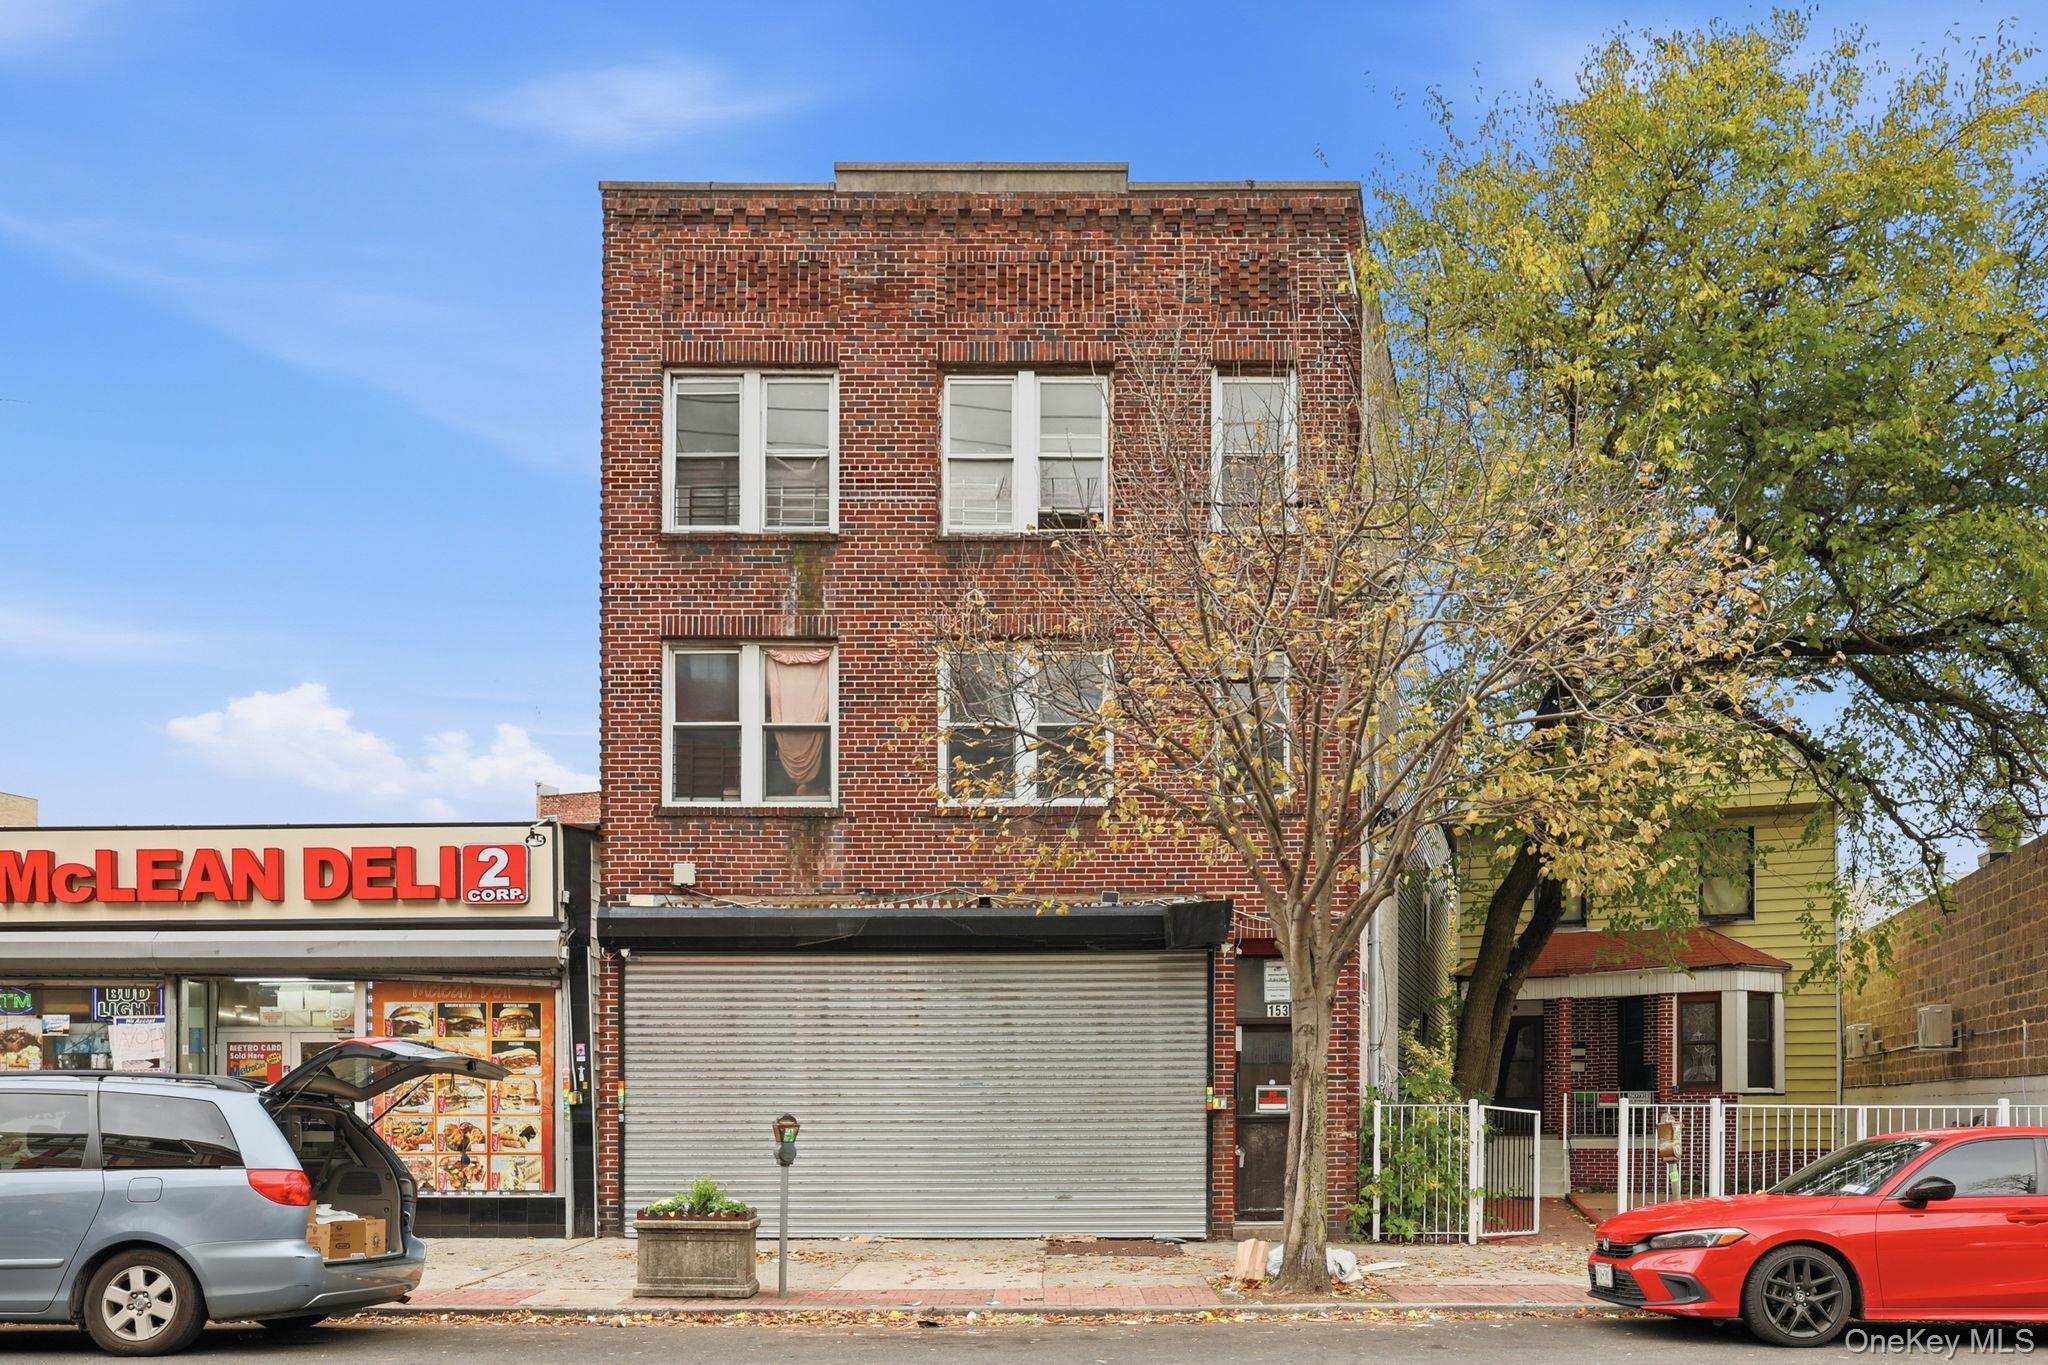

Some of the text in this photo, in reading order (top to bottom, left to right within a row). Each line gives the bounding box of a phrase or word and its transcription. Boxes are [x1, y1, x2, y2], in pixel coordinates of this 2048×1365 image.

[0, 846, 510, 904] McLEAN DELI 2
[467, 888, 525, 902] CORP.
[0, 993, 32, 1008] TM
[106, 988, 150, 1002] BUD
[98, 1001, 158, 1017] LIGHT
[1269, 1005, 1288, 1016] 153
[248, 1052, 265, 1060] Here
